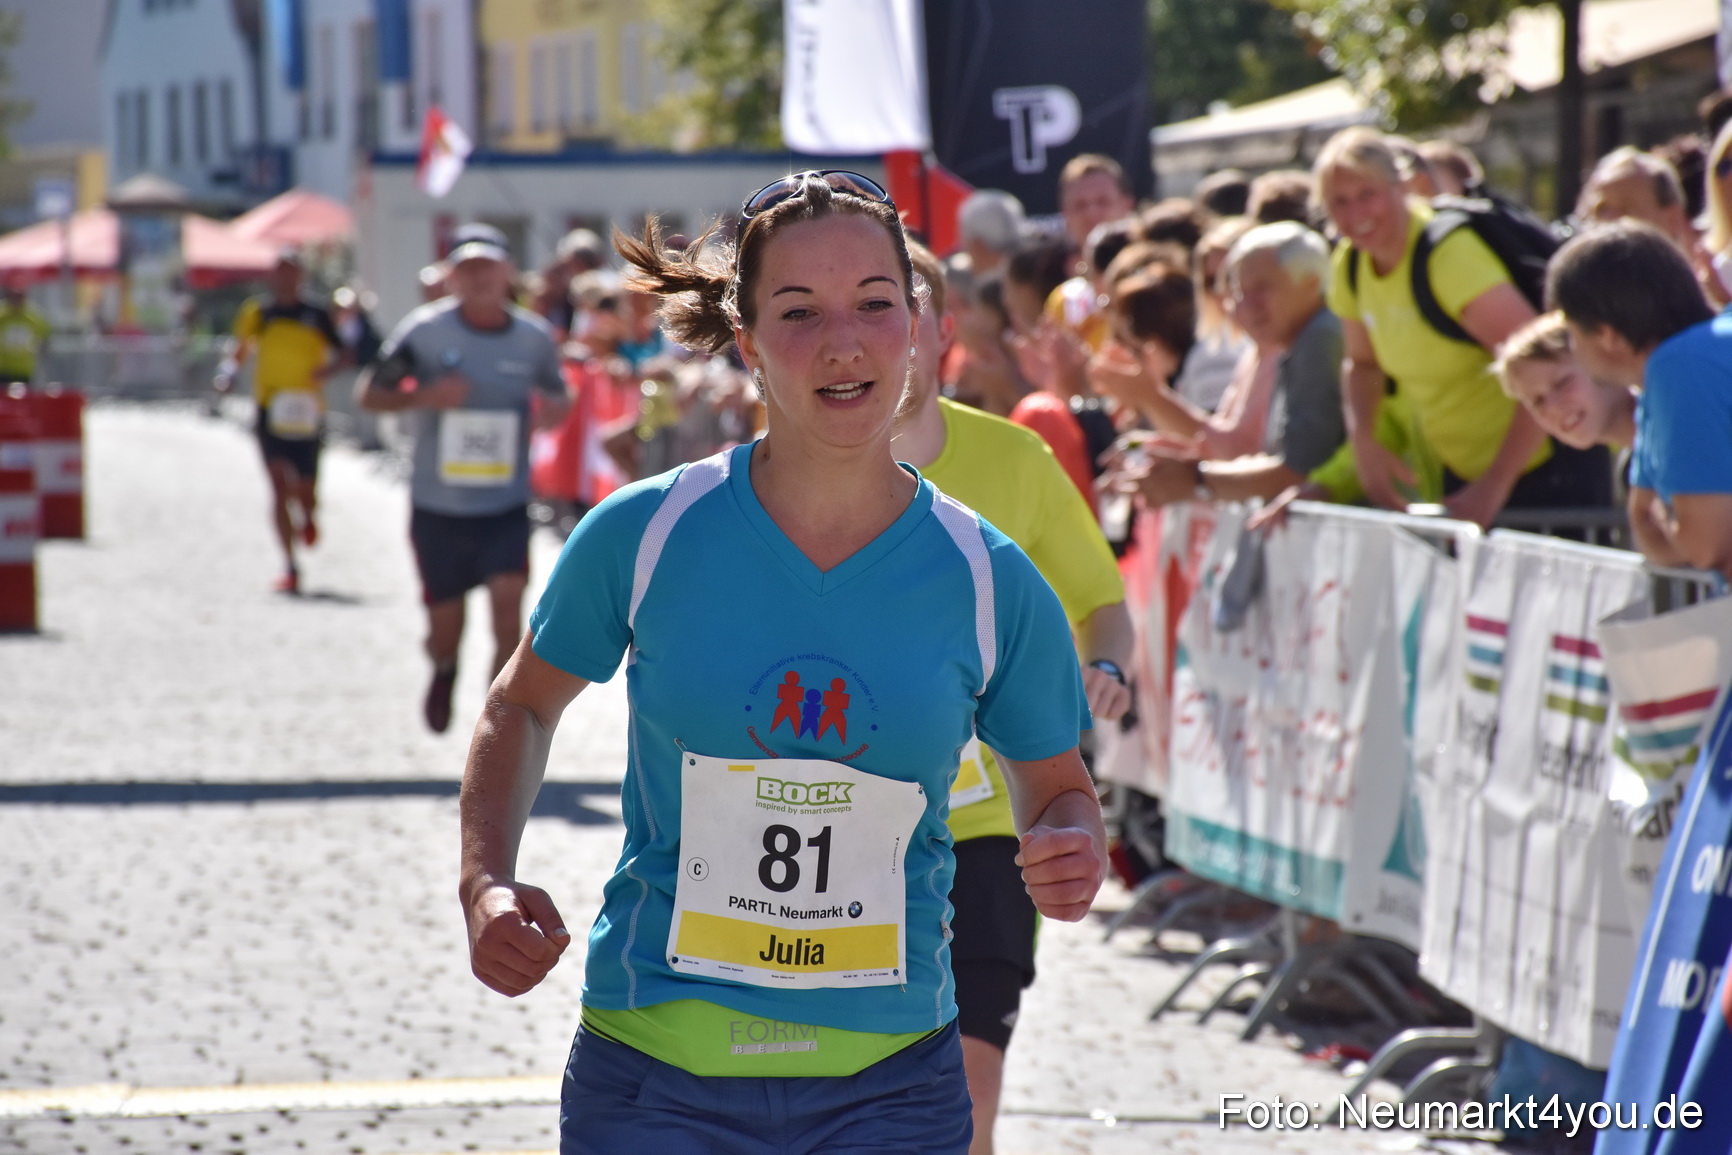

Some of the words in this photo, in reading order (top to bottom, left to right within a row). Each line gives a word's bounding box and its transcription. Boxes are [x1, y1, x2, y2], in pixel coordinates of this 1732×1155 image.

[748, 655, 795, 696] Elterninitiative
[797, 652, 853, 673] krebskranker
[851, 671, 872, 697] Kinder
[868, 697, 880, 714] e.V.
[757, 777, 856, 806] BOCK
[755, 799, 786, 813] inspired
[787, 805, 798, 816] by
[799, 806, 822, 815] smart
[823, 804, 852, 814] concepts
[693, 863, 702, 876] C
[757, 824, 832, 894] 81
[1691, 844, 1732, 897] ON
[728, 896, 777, 916] PARTL
[779, 895, 843, 920] Neumarkt
[759, 934, 825, 966] Julia
[729, 1020, 817, 1043] FORM
[735, 1041, 814, 1055] BELT
